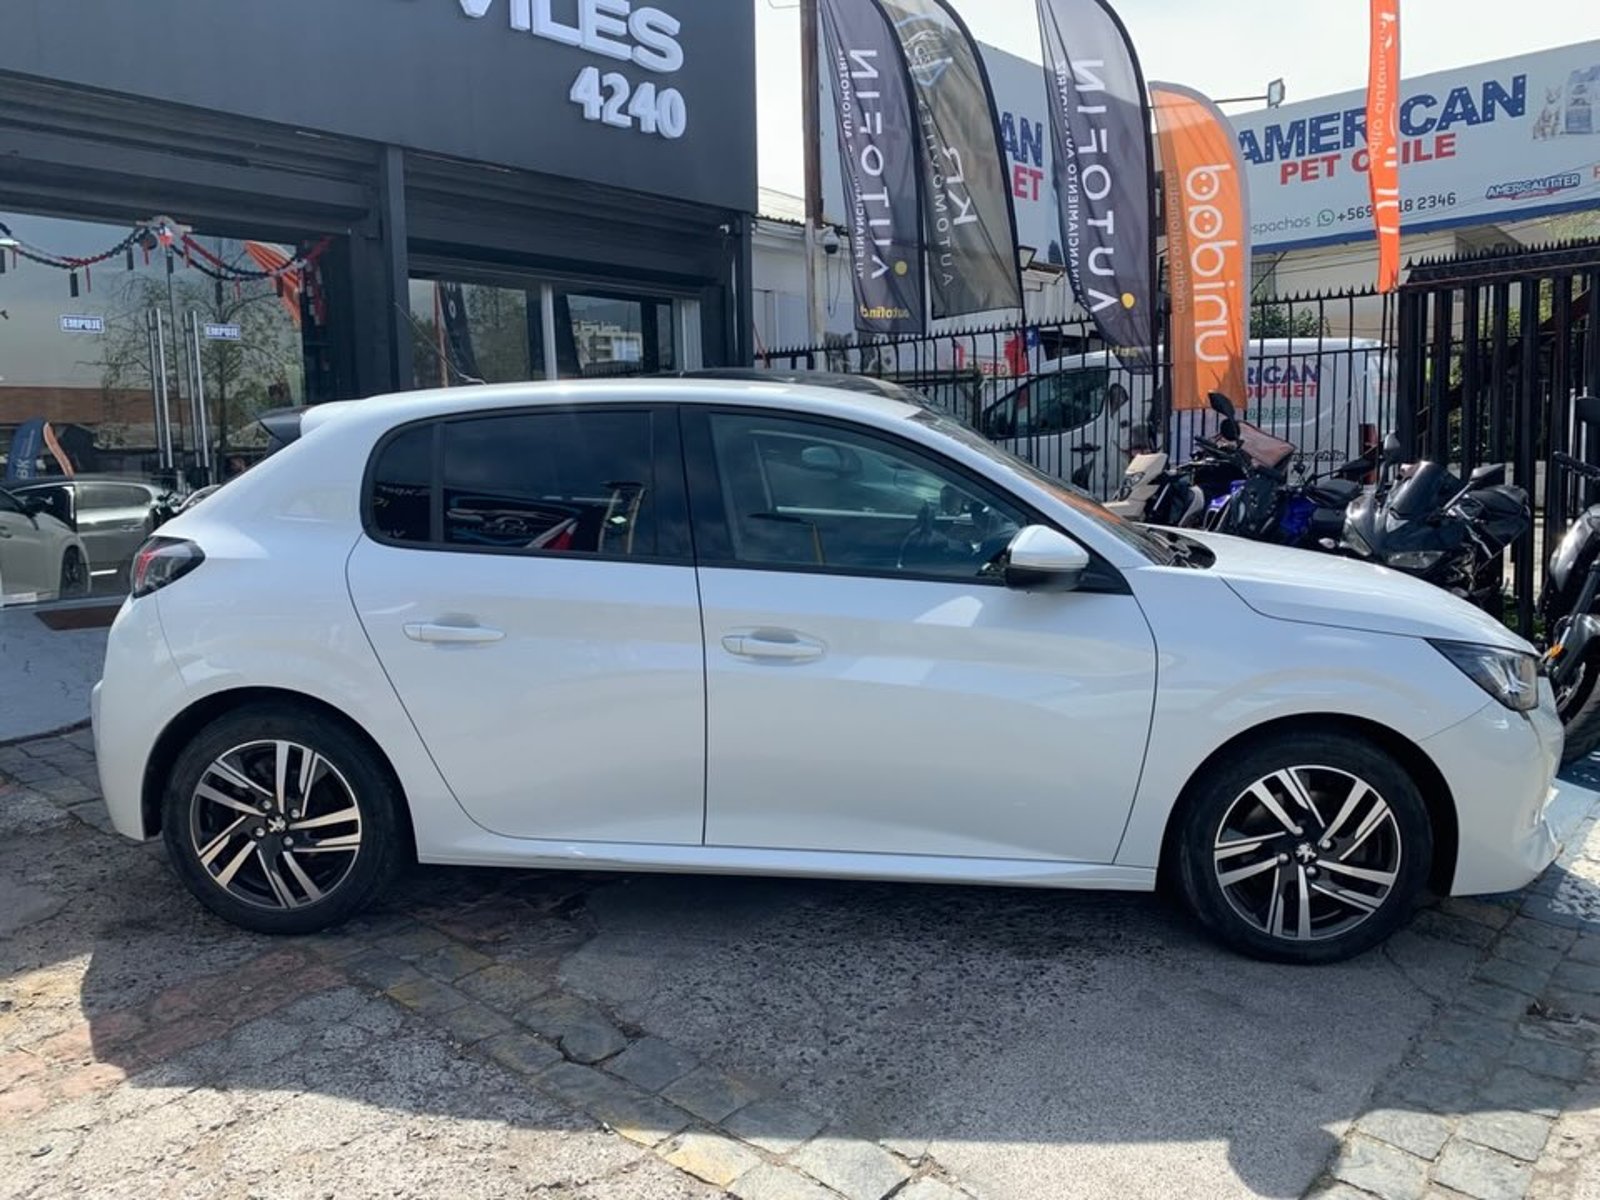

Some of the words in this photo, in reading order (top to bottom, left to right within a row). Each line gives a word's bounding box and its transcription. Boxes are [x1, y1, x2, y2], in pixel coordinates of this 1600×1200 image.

[570, 66, 686, 138] 4240
[1238, 74, 1526, 164] AMERCAN
[1280, 153, 1341, 185] PET
[1352, 133, 1456, 172] CILE
[1418, 192, 1456, 211] 2346
